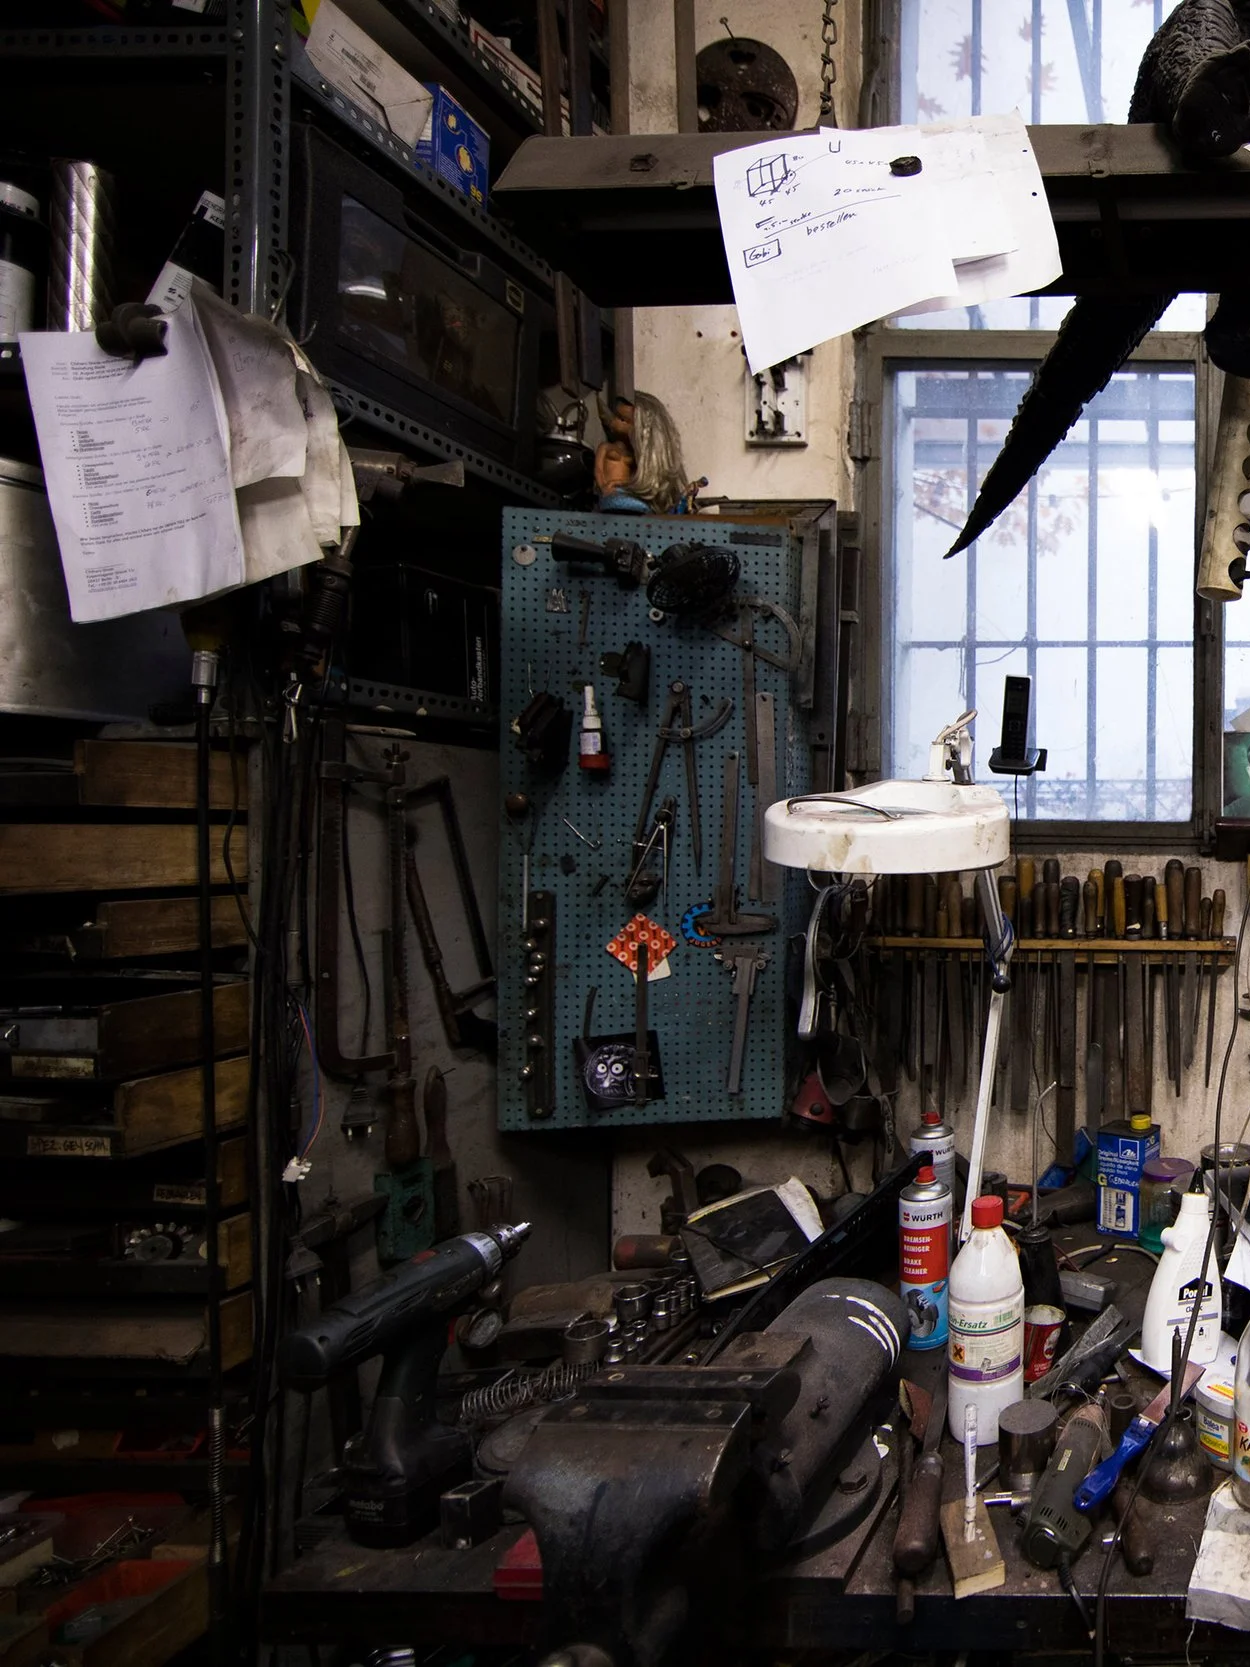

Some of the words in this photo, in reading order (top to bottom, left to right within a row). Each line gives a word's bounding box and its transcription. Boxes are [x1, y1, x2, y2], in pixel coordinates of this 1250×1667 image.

[806, 212, 857, 236] bestellen
[904, 1236, 932, 1244] BREMSEN-
[904, 1245, 930, 1253] REINIGER
[904, 1257, 922, 1265] BRAKE
[904, 1266, 928, 1275] CLEANER
[1203, 1415, 1220, 1431] Balea
